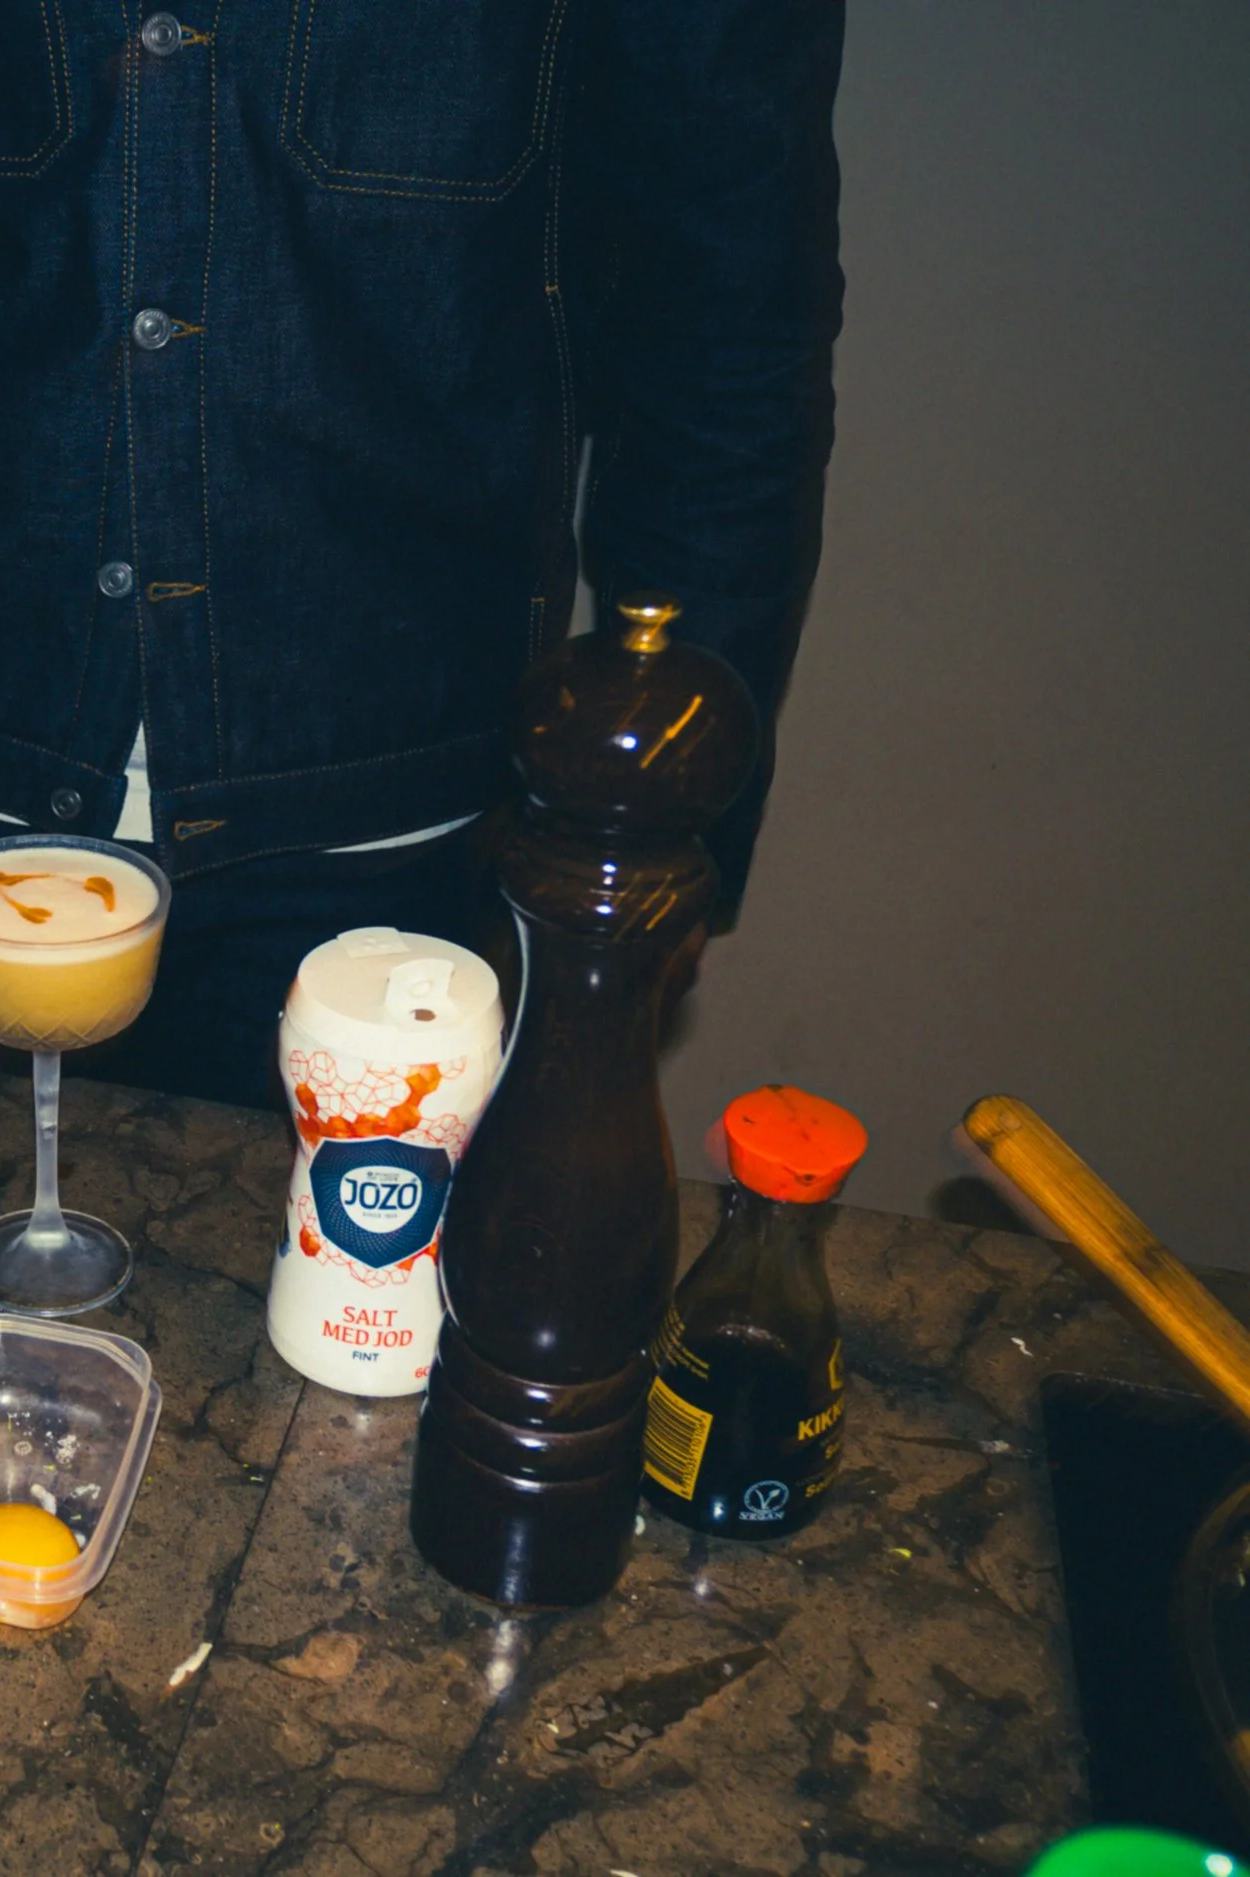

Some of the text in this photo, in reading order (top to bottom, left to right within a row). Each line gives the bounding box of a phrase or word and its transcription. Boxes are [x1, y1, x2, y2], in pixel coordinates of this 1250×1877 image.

[344, 1178, 418, 1210] JOZO
[342, 1305, 398, 1328] SALT
[322, 1319, 413, 1348] MED JOD
[352, 1350, 379, 1362] FINT
